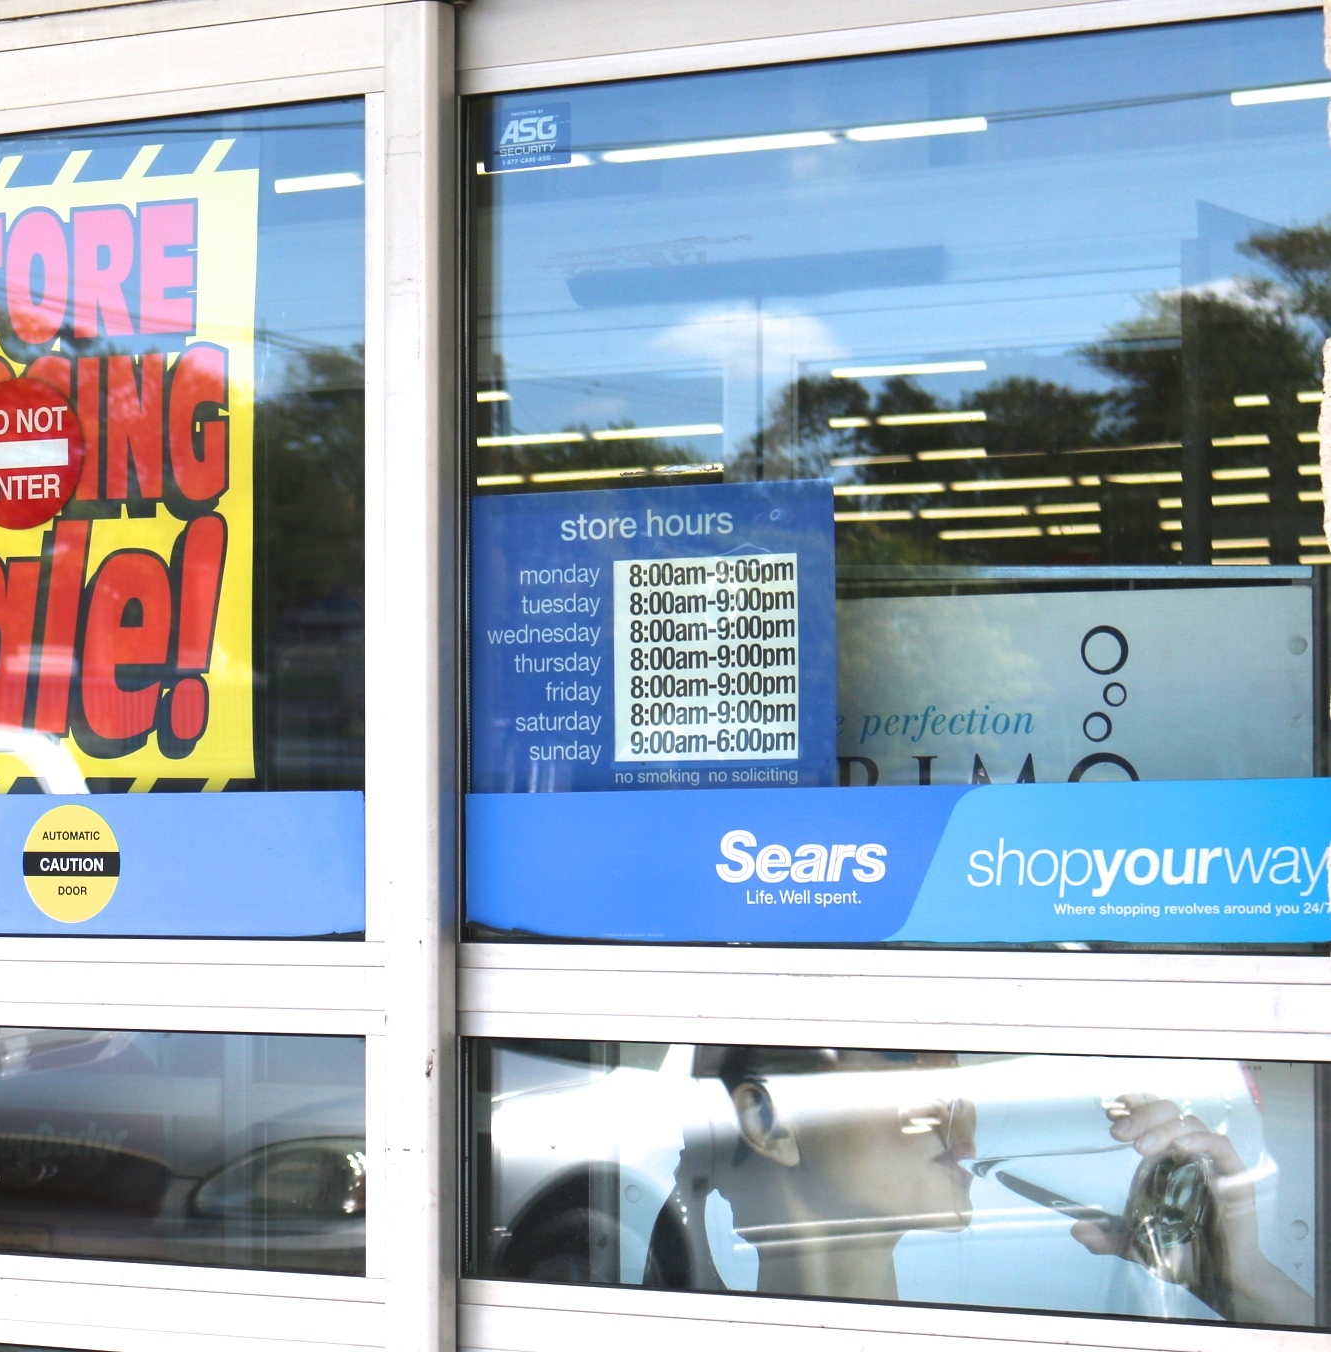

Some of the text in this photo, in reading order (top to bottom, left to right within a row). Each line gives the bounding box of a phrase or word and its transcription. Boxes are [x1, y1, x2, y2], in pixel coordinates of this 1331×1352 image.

[499, 115, 557, 145] ASG
[499, 143, 556, 157] SECURITY
[16, 406, 68, 433] NOT
[560, 509, 733, 541] store hours
[520, 559, 794, 587] monday 8:00am-9:00pm
[521, 587, 795, 616] tuesday 8:00am-9:00pm
[487, 615, 795, 646] wednesday 8:00am-9:00pm
[514, 643, 796, 675] thursday 8:00am-9:00pm
[545, 672, 796, 705] friday 8:00am-9:00pm
[515, 700, 796, 734] saturday 8:00am-9:00pm
[859, 705, 1035, 745] perfection
[529, 728, 796, 764] sunday 9:00am-6:00pm
[615, 767, 798, 786] no smoking no soliciting
[42, 831, 100, 841] AUTOMATIC
[39, 857, 104, 872] CAUTION
[715, 829, 888, 883] Sears
[967, 837, 1330, 897] shopyourway
[57, 886, 87, 896] DOOR
[746, 889, 862, 907] Life. Well spent.
[1054, 903, 1096, 915] Where
[1100, 903, 1160, 917] shopping
[1164, 903, 1220, 915] revolves
[1224, 902, 1271, 915] around
[1275, 905, 1300, 916] you
